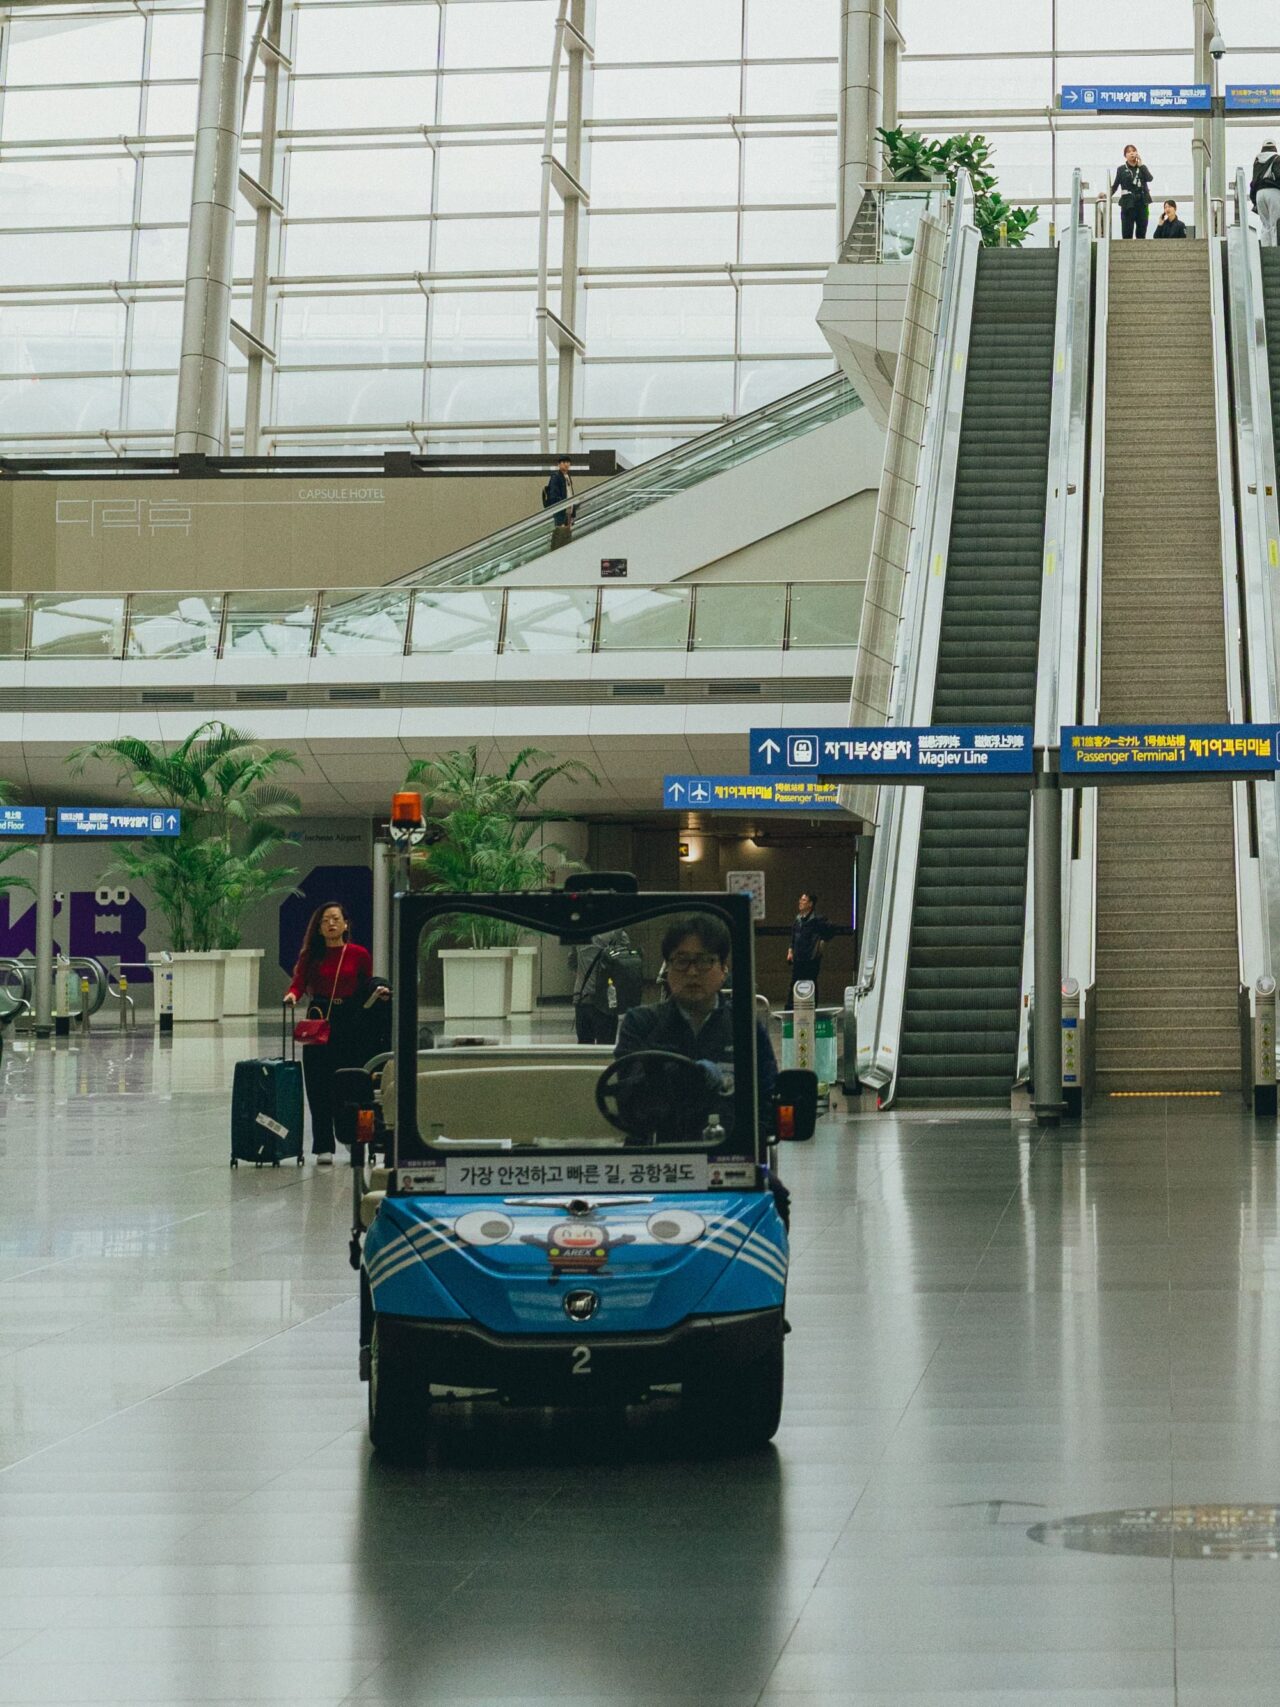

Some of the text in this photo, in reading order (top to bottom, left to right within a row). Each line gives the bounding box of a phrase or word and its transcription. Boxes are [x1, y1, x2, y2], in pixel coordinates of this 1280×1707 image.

[1151, 96, 1187, 106] Maglev Line
[299, 488, 385, 499] CAPSULE HOTEL
[824, 740, 912, 761] 자기부상열차
[1189, 738, 1271, 757] 제1여객터미널
[919, 750, 988, 767] Maglev Line
[1076, 749, 1186, 766] Passenger Terminal 1
[714, 785, 773, 799] 제1여객터미널
[774, 793, 812, 804] Passenger
[7, 821, 25, 830] Floor
[77, 822, 108, 832] Maglev Line
[460, 1163, 695, 1187] 가장 안전하고 빠른 길, 공항철도
[563, 1249, 593, 1257] AREX
[572, 1345, 592, 1374] 2
